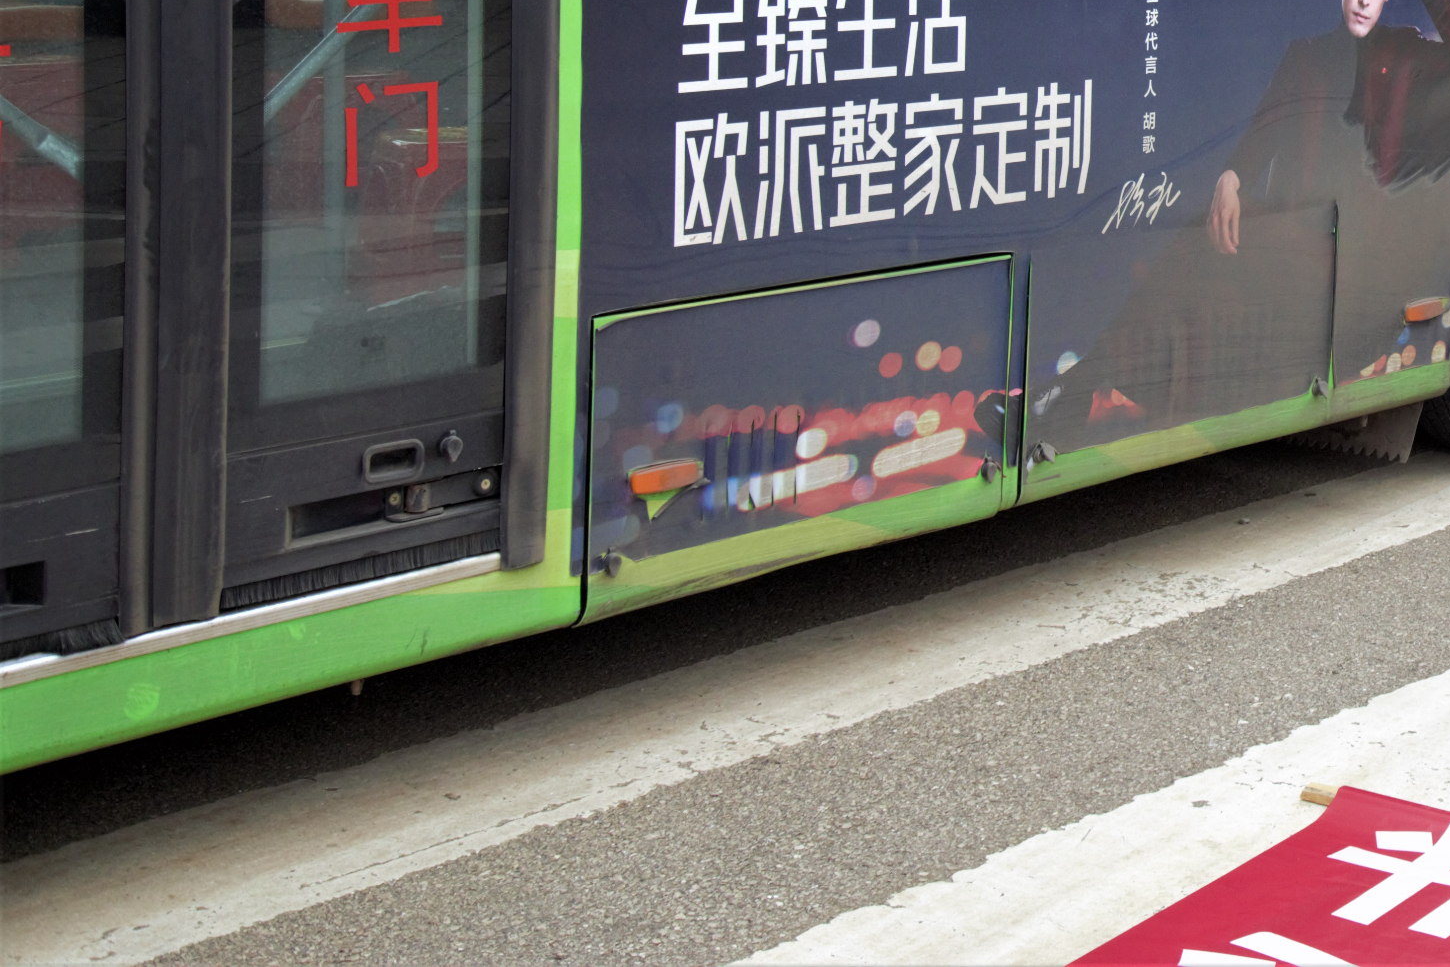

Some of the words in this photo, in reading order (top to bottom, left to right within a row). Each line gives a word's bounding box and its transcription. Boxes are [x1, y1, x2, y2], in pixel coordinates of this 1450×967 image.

[673, 78, 1093, 248] 欧派整家定制
[1141, 111, 1157, 155] 胡歌
